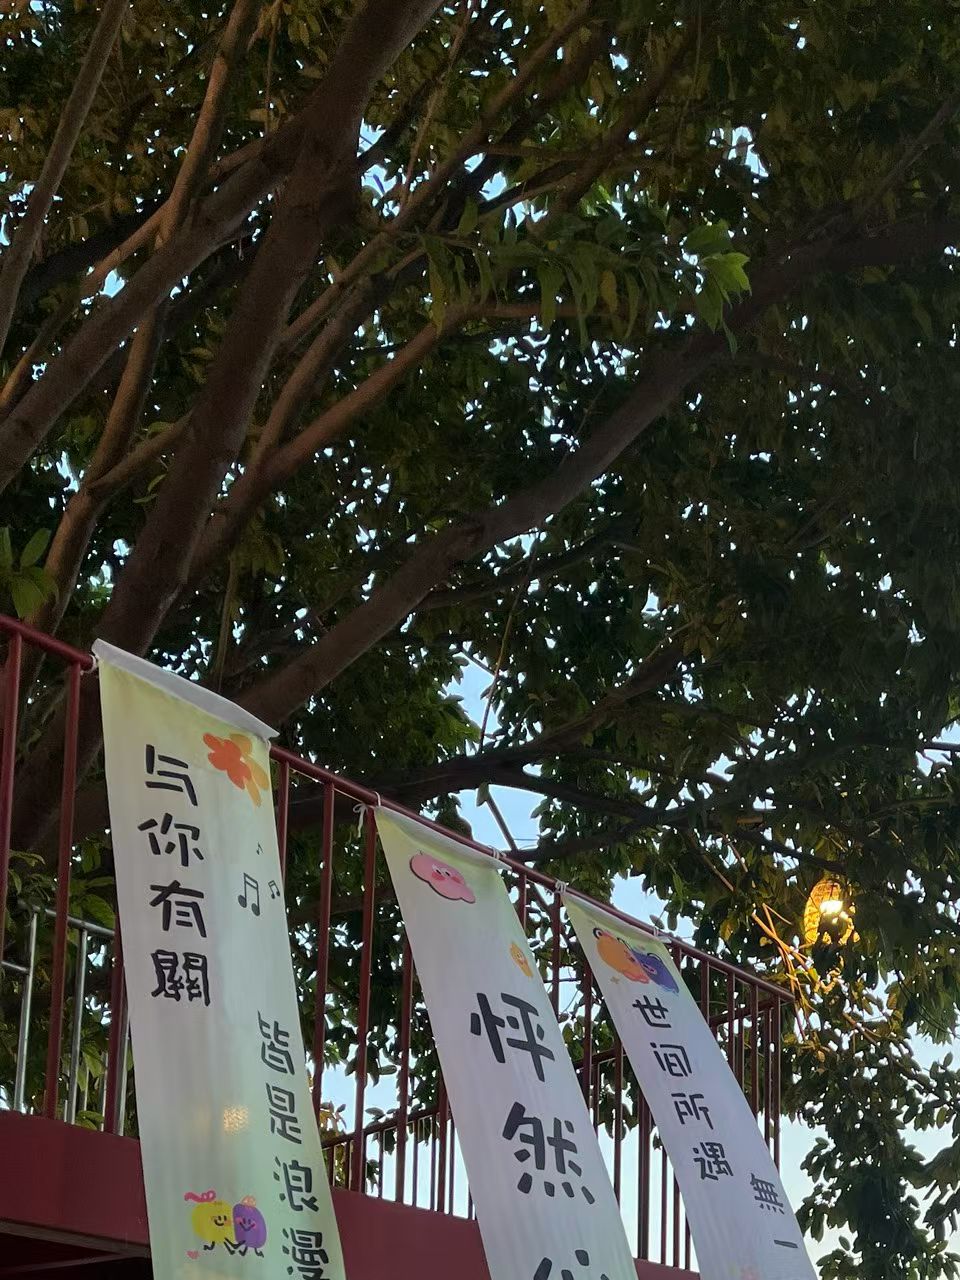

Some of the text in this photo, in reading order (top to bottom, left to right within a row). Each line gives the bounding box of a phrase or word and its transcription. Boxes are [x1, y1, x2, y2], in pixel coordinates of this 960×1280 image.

[138, 744, 210, 1006] 与你有關
[632, 994, 733, 1180] 世间所遇
